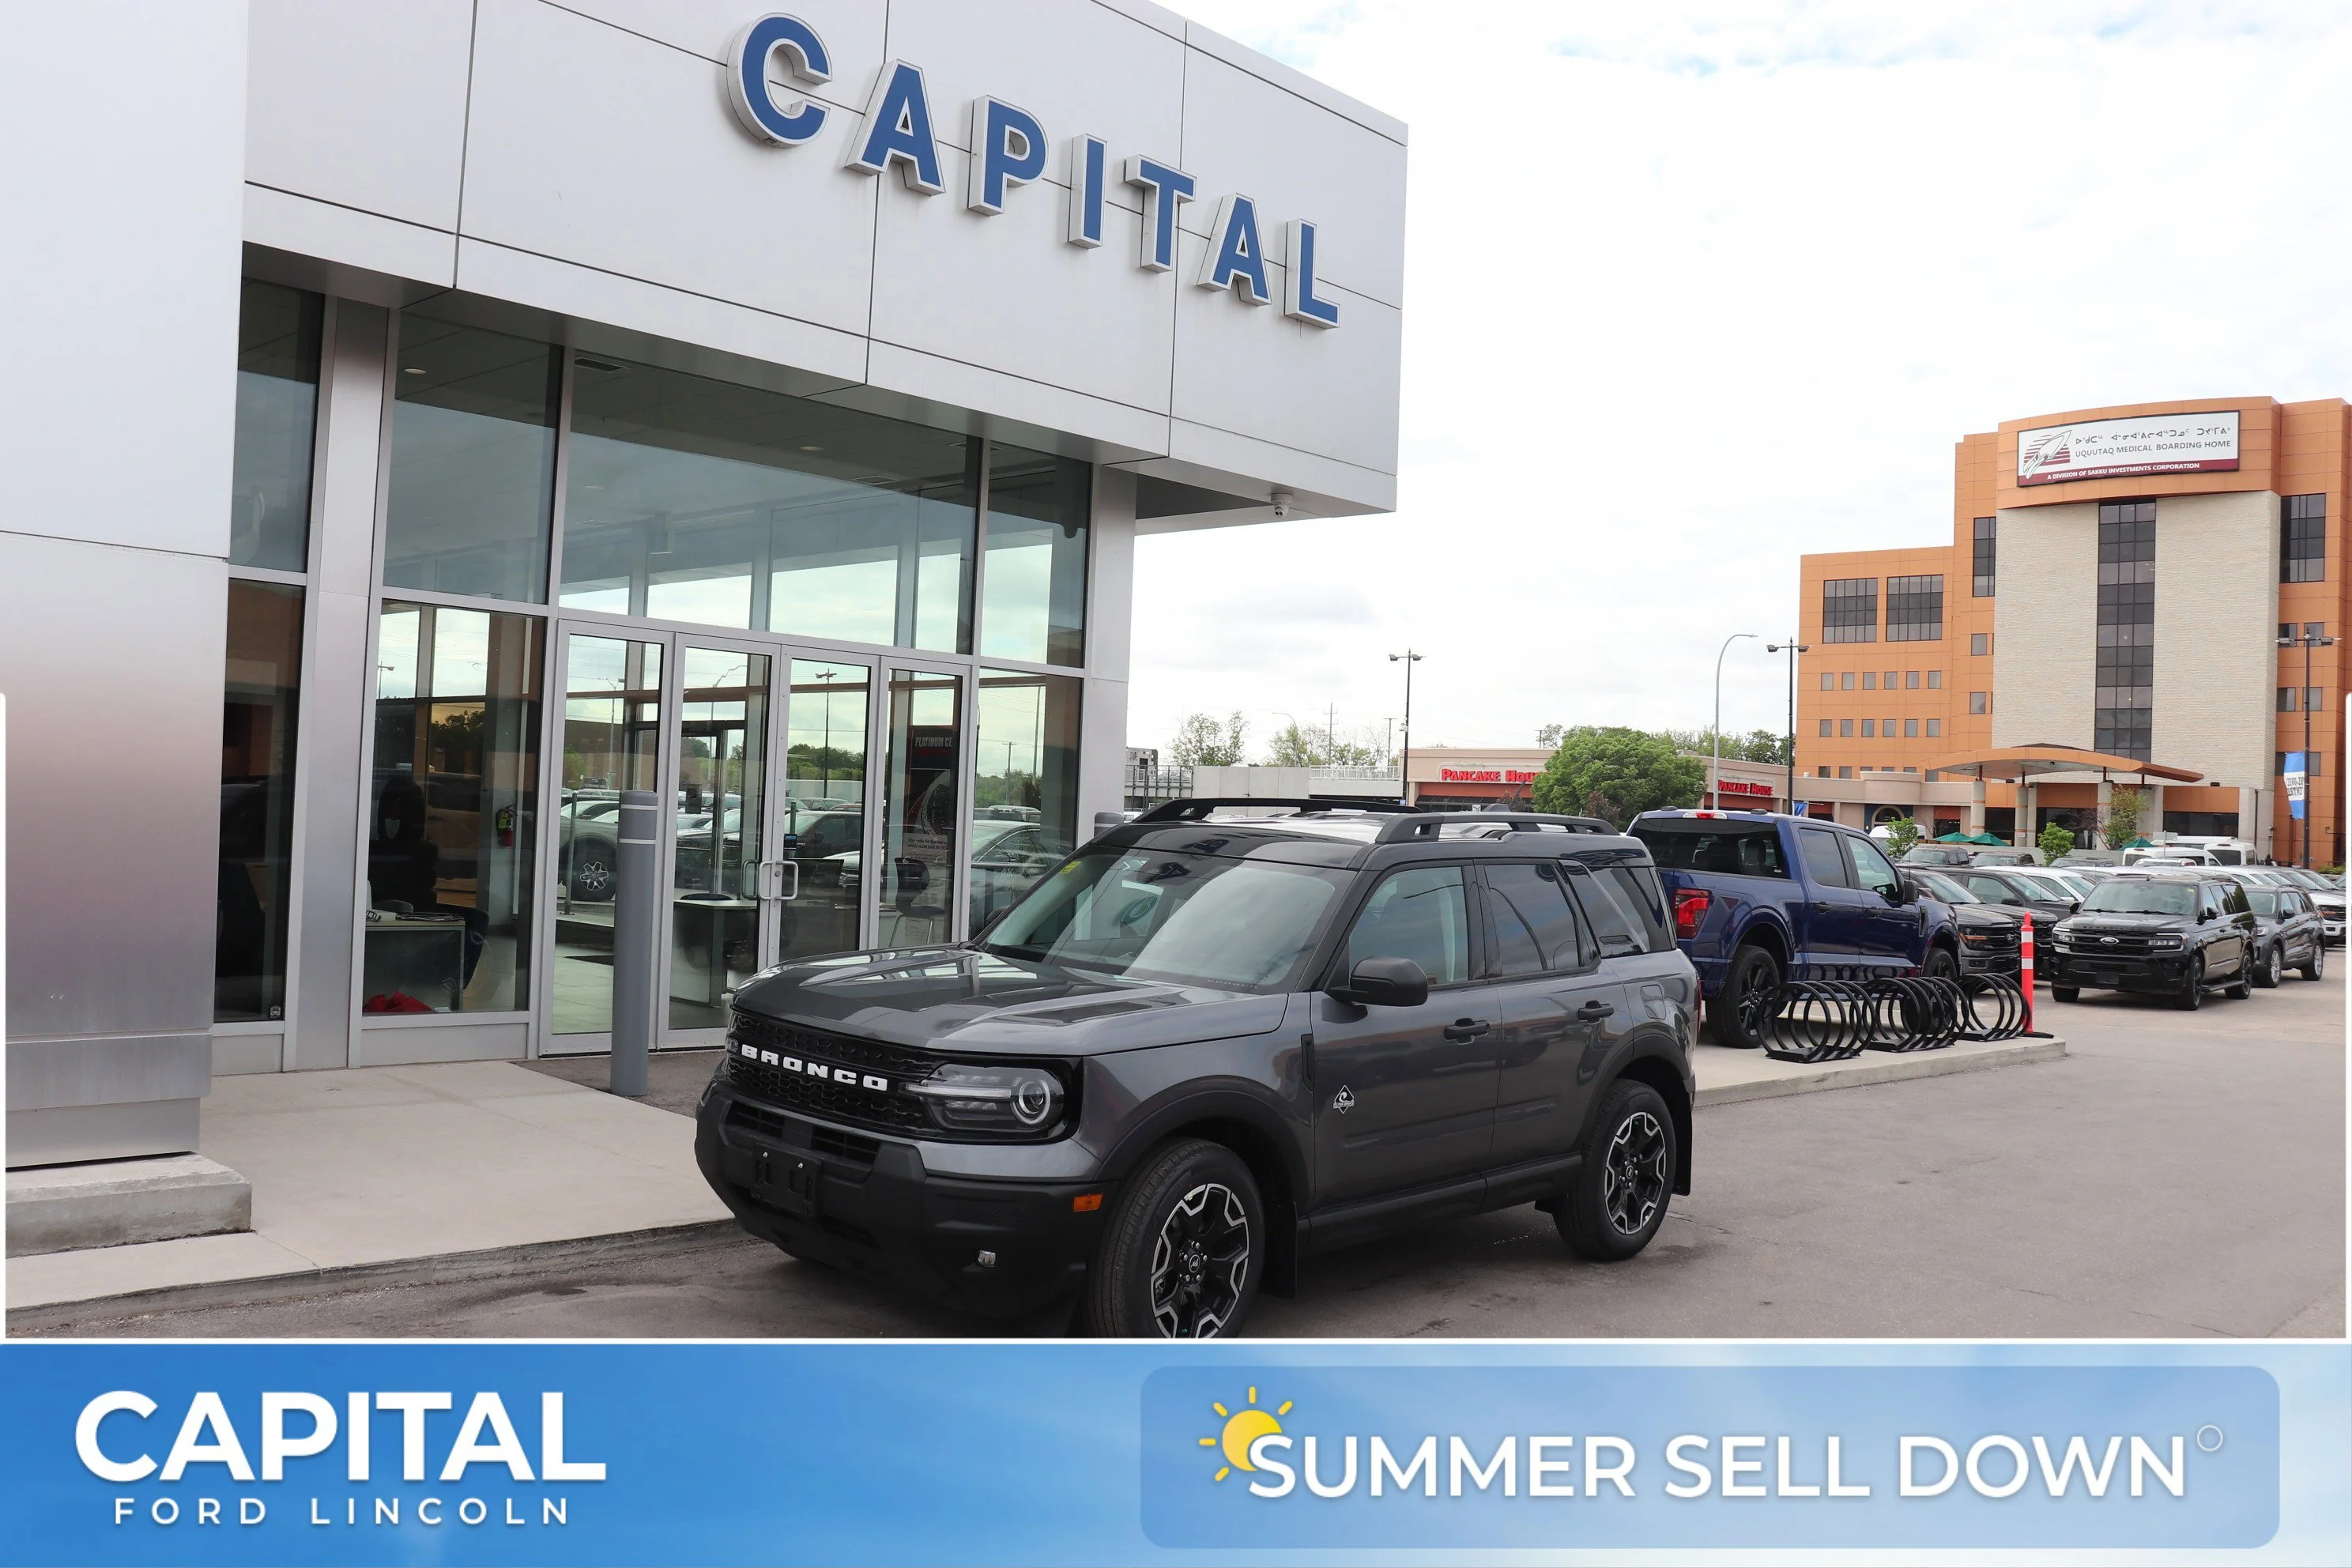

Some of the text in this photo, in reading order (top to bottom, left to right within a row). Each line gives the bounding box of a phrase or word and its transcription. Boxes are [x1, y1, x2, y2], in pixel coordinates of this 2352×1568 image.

[726, 12, 1340, 330] CAPITAL
[2075, 447, 2114, 458] UQUUTAQ
[2116, 444, 2153, 453] MEDICAL
[2156, 442, 2202, 450] BOARDING
[914, 737, 944, 747] PLATINUM
[1442, 768, 1545, 782] PANCAKE HOU
[1718, 779, 1773, 796] PANCAKE HOUSE
[741, 1044, 888, 1091] BRONCO
